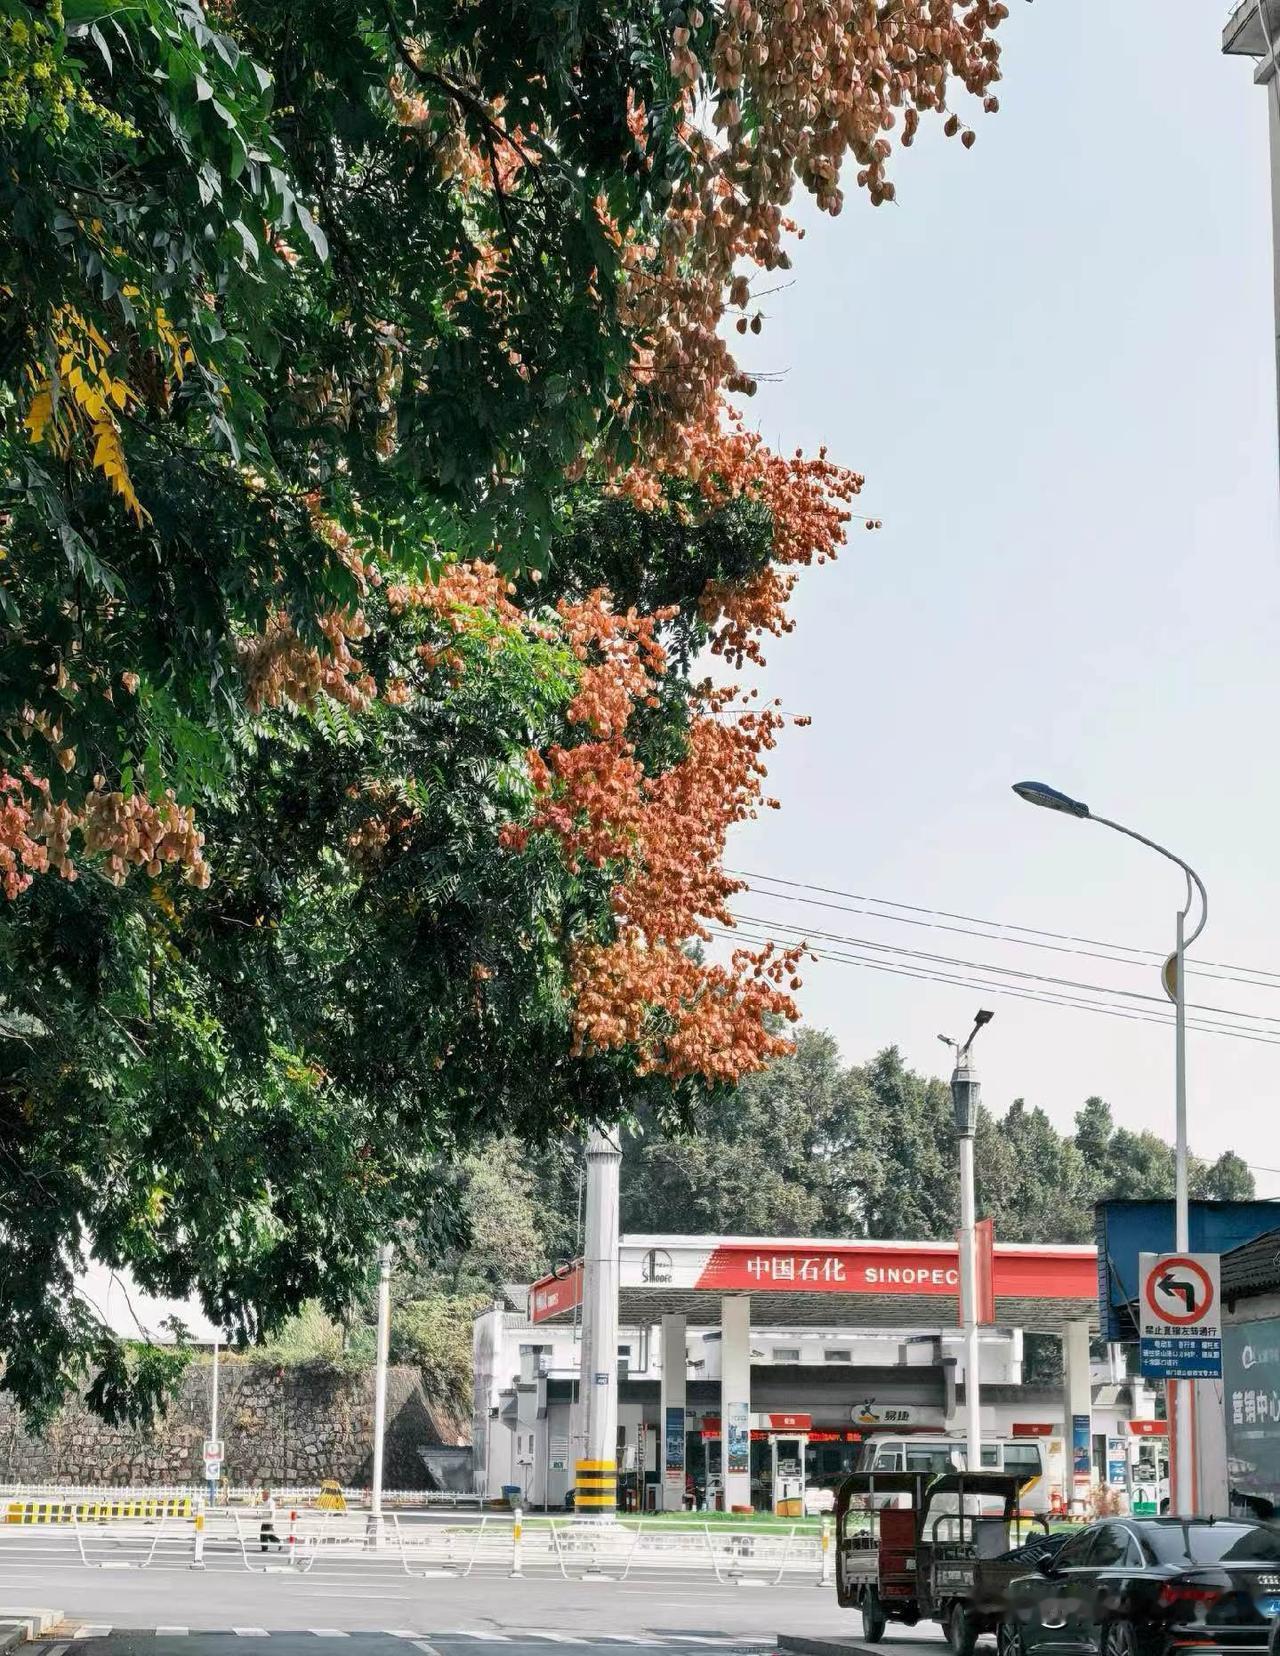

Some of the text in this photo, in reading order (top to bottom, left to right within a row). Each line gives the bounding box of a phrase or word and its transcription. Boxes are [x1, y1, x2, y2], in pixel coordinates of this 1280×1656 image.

[747, 1256, 959, 1285] 中国石化 SINOPEC
